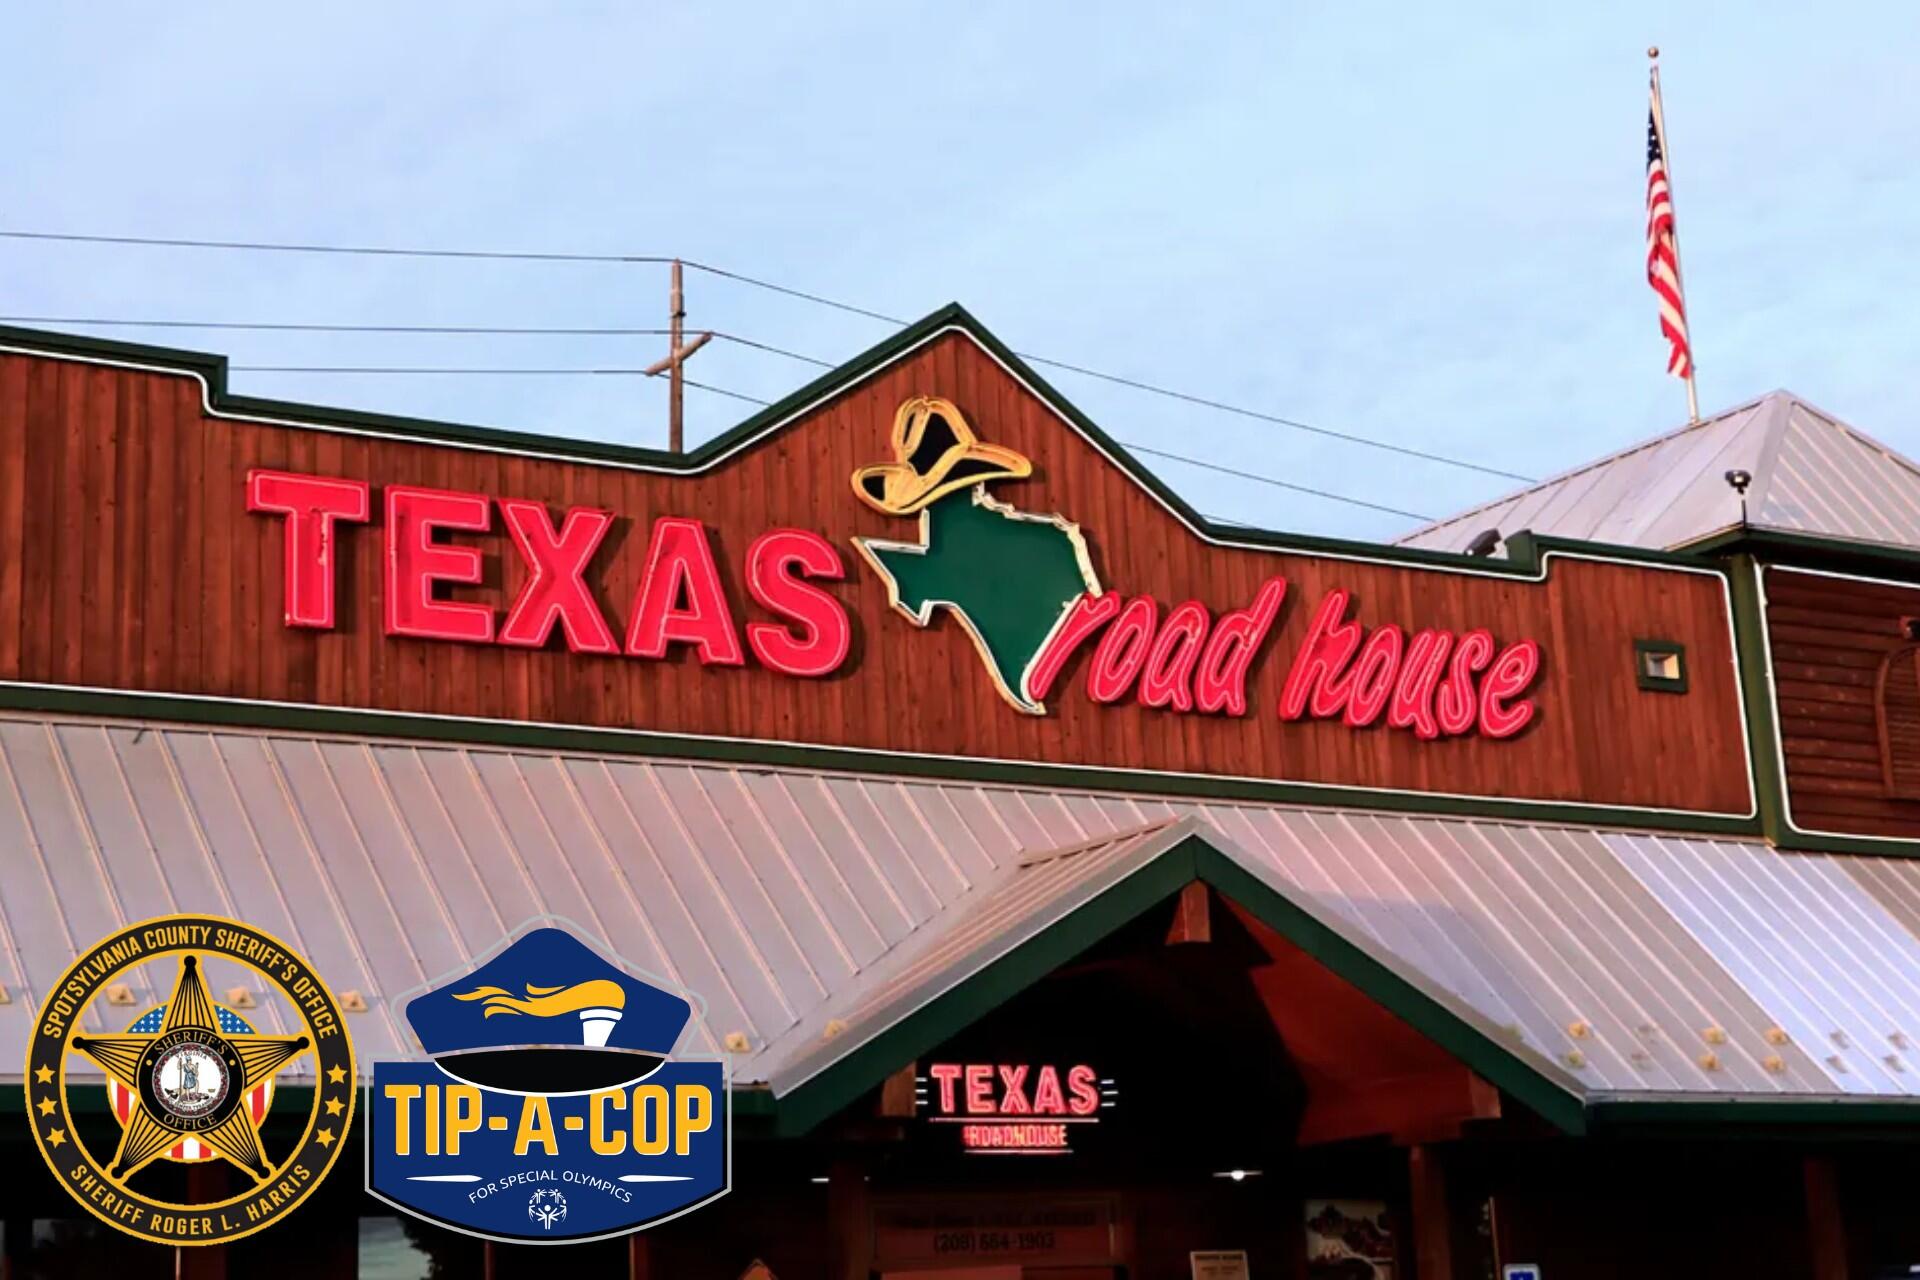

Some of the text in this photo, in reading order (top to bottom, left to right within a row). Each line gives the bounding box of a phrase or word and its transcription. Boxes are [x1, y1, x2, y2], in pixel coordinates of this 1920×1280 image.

[246, 469, 851, 679] TEXAS
[1027, 576, 1539, 741] road house
[930, 1064, 1099, 1115] TEXAS
[963, 1125, 1069, 1147] ROADHOUSE
